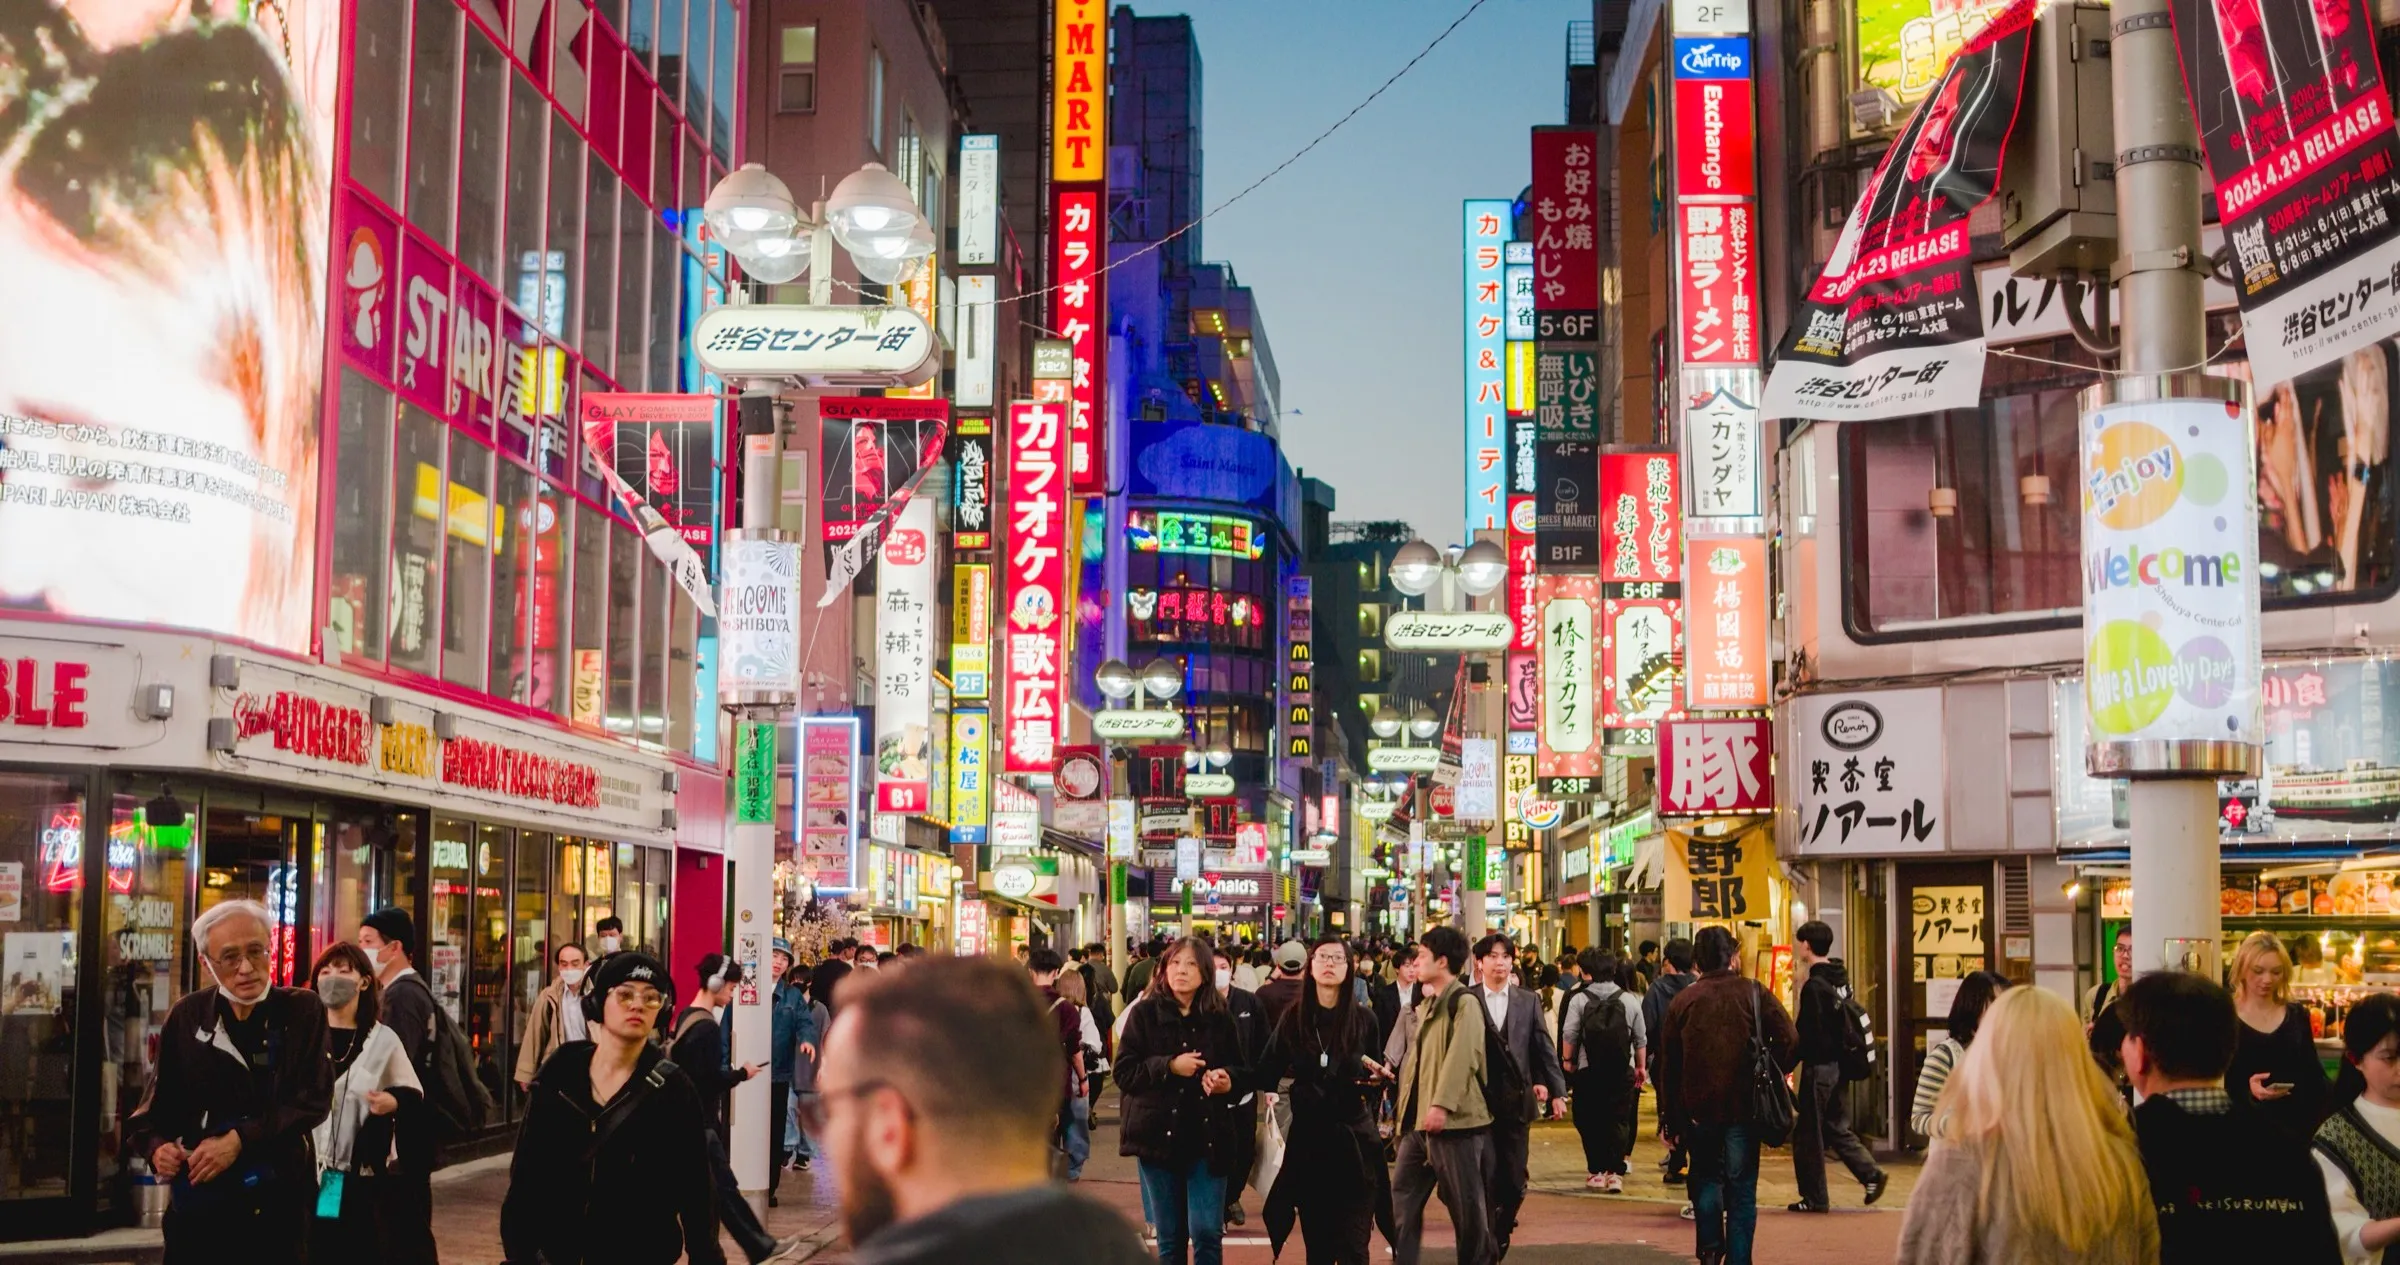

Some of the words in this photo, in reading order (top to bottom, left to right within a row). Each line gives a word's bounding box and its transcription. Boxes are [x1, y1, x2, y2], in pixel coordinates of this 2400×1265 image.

[1698, 6, 1724, 22] 2F
[1692, 53, 1741, 71] AirTrip
[1066, 0, 1095, 169] -MART
[1701, 85, 1723, 189] Exchange
[2225, 149, 2301, 213] 2025.4.23
[2303, 100, 2381, 164] RELEASE
[964, 153, 978, 248] モニタールーム
[1565, 143, 1593, 250] お好み焼
[1537, 197, 1565, 302] もんじゃ
[1891, 230, 1960, 270] RELEASE
[1687, 206, 1725, 361] 野郎ラーメン
[706, 326, 917, 352] 渋谷センター街
[1539, 355, 1565, 429] 無呼吸
[1568, 354, 1596, 429] いびき
[1795, 360, 1950, 399] 渋谷センター街
[588, 405, 637, 419] GLAY
[825, 405, 873, 416] GLAY
[1556, 443, 1577, 456] 4F
[1711, 421, 1733, 507] カンダヤ
[1013, 404, 1058, 583] カラオケ
[2089, 444, 2174, 515] Enjoy
[51, 489, 116, 512] JAPAN
[119, 495, 191, 524] 株式会社
[1563, 515, 1597, 528] MARKET
[1647, 457, 1673, 579] 築地もんじゃ
[1552, 546, 1582, 560] B1F
[1614, 494, 1641, 578] お好み焼
[2088, 544, 2241, 595] Welcome
[1519, 545, 1536, 649] バーガーキング
[2153, 584, 2192, 620] Shibuya
[732, 617, 791, 633] SHIBUYA
[885, 588, 910, 698] 麻辣湯
[1394, 623, 1506, 638] 渋谷センター街
[959, 676, 981, 691] 2F
[1552, 616, 1585, 735] 椿屋カフェ
[2137, 654, 2196, 697] Lovely
[2198, 654, 2235, 683] Day!
[1009, 633, 1056, 764] 歌広場
[1098, 717, 1178, 730] 渋谷センター街
[959, 746, 980, 790] 松屋
[1669, 722, 1761, 810] 豚
[1812, 754, 1895, 796] 喫茶室
[891, 789, 920, 808] B1
[1524, 800, 1559, 819] KING
[1506, 821, 1529, 840] B1
[1170, 876, 1259, 895] MDnald's
[1687, 837, 1747, 921] 野郎
[1940, 895, 1982, 915] 喫茶室
[118, 932, 175, 961] SCRAMBLE
